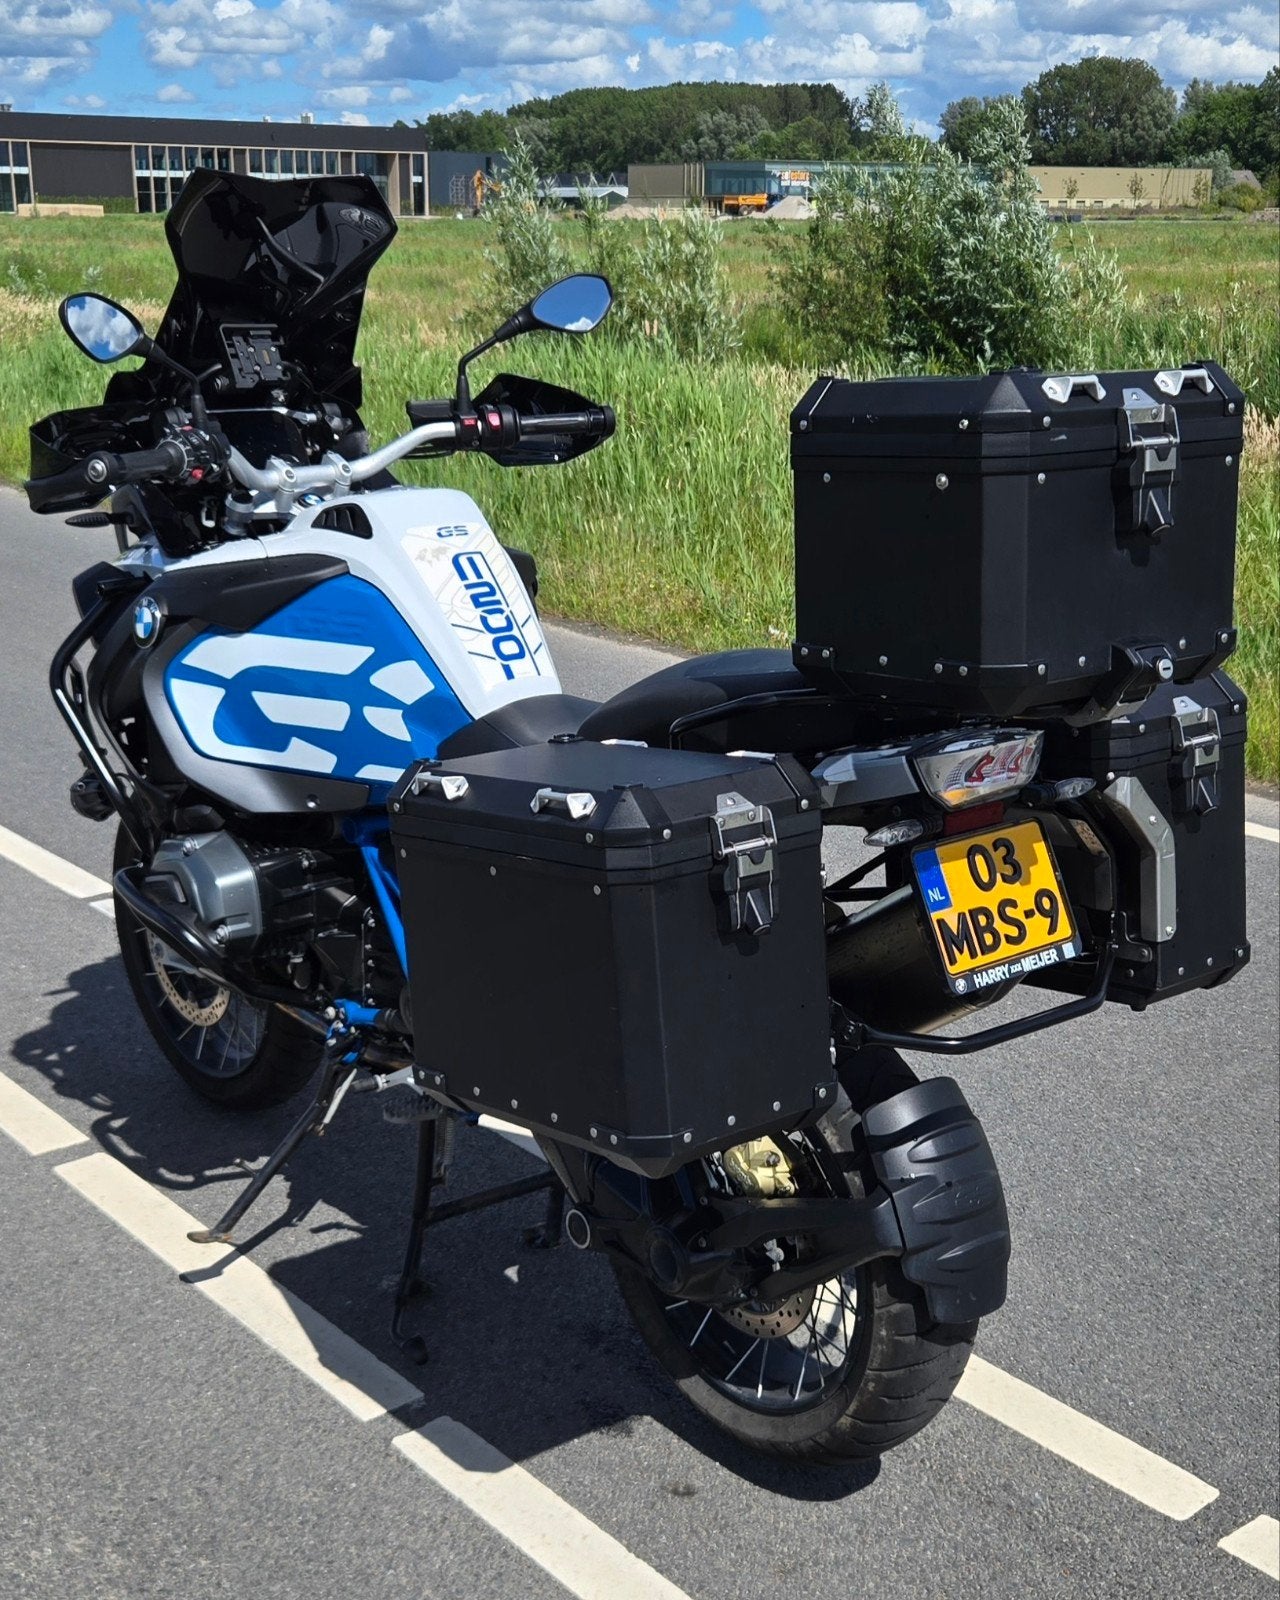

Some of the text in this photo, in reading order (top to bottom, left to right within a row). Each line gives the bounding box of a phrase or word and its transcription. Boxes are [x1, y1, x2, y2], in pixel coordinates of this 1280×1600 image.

[436, 525, 469, 538] GS
[966, 837, 1022, 892] 03
[927, 887, 946, 903] NL
[936, 888, 1060, 967] MBS-9
[973, 963, 1010, 989] HARRY
[1020, 948, 1060, 973] MEIJER
